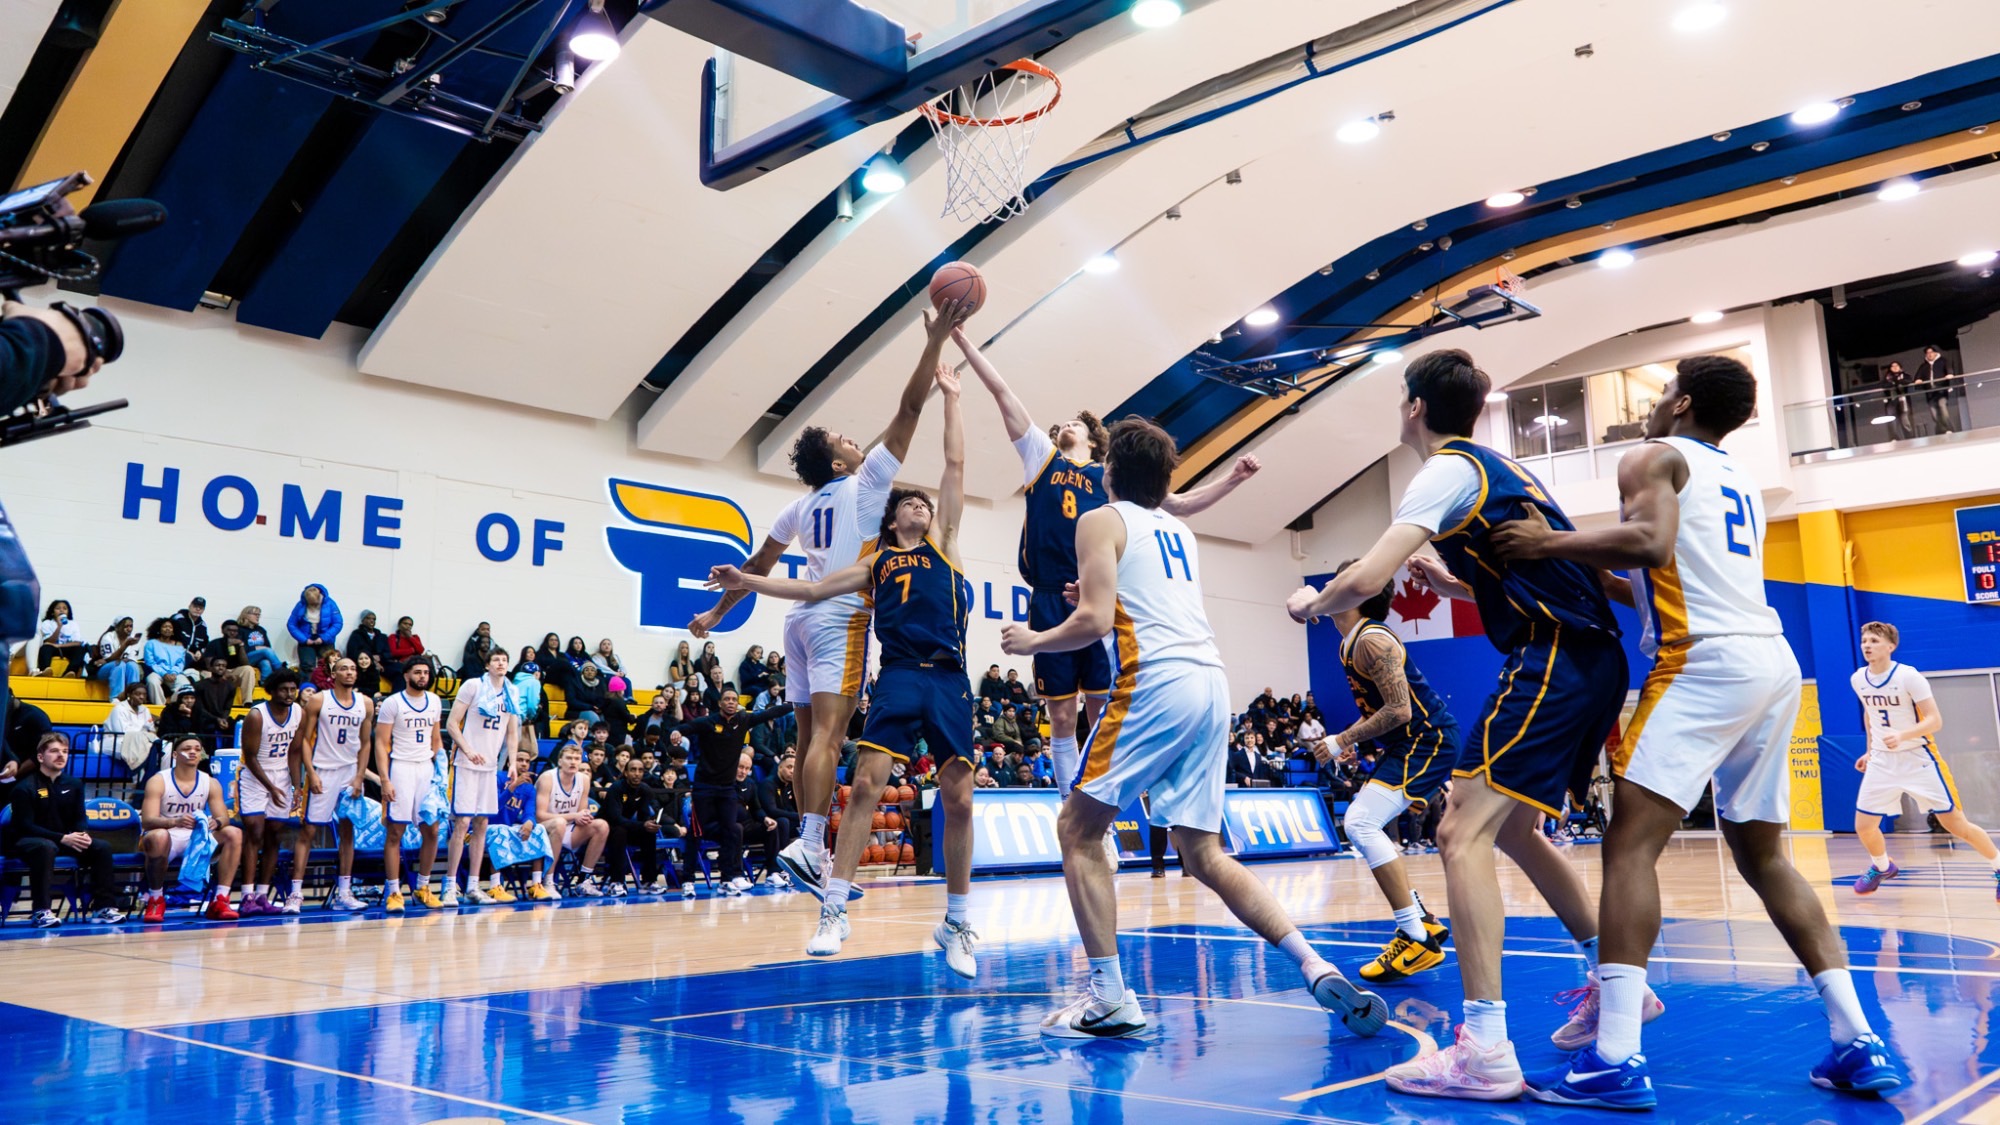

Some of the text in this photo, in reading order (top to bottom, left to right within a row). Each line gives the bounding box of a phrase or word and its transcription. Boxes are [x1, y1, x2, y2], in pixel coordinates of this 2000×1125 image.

[1062, 489, 1078, 519] 8
[122, 462, 566, 567] HOME OF
[1719, 484, 1760, 560] 21
[812, 507, 834, 549] 11
[1154, 529, 1193, 582] 14
[880, 553, 932, 585] QUEEN'S
[1972, 565, 1996, 574] FOULS
[895, 572, 912, 604] 7
[1981, 573, 1995, 590] 0
[1975, 591, 2000, 600] SCORE
[1862, 695, 1901, 706] TMU
[328, 714, 361, 727] TMU
[404, 718, 435, 728] TMU
[483, 714, 501, 730] 22
[1878, 709, 1891, 727] 3
[337, 728, 347, 744] 8
[415, 730, 425, 742] 6
[269, 742, 289, 758] 23
[1792, 758, 1814, 767] first
[1794, 769, 1819, 779] TMU
[166, 802, 201, 814] TMU
[554, 799, 578, 810] TMU
[85, 808, 131, 820] BOLD
[972, 802, 1064, 856] TM
[1114, 820, 1140, 831] BOLD
[1229, 799, 1325, 846] TMU
